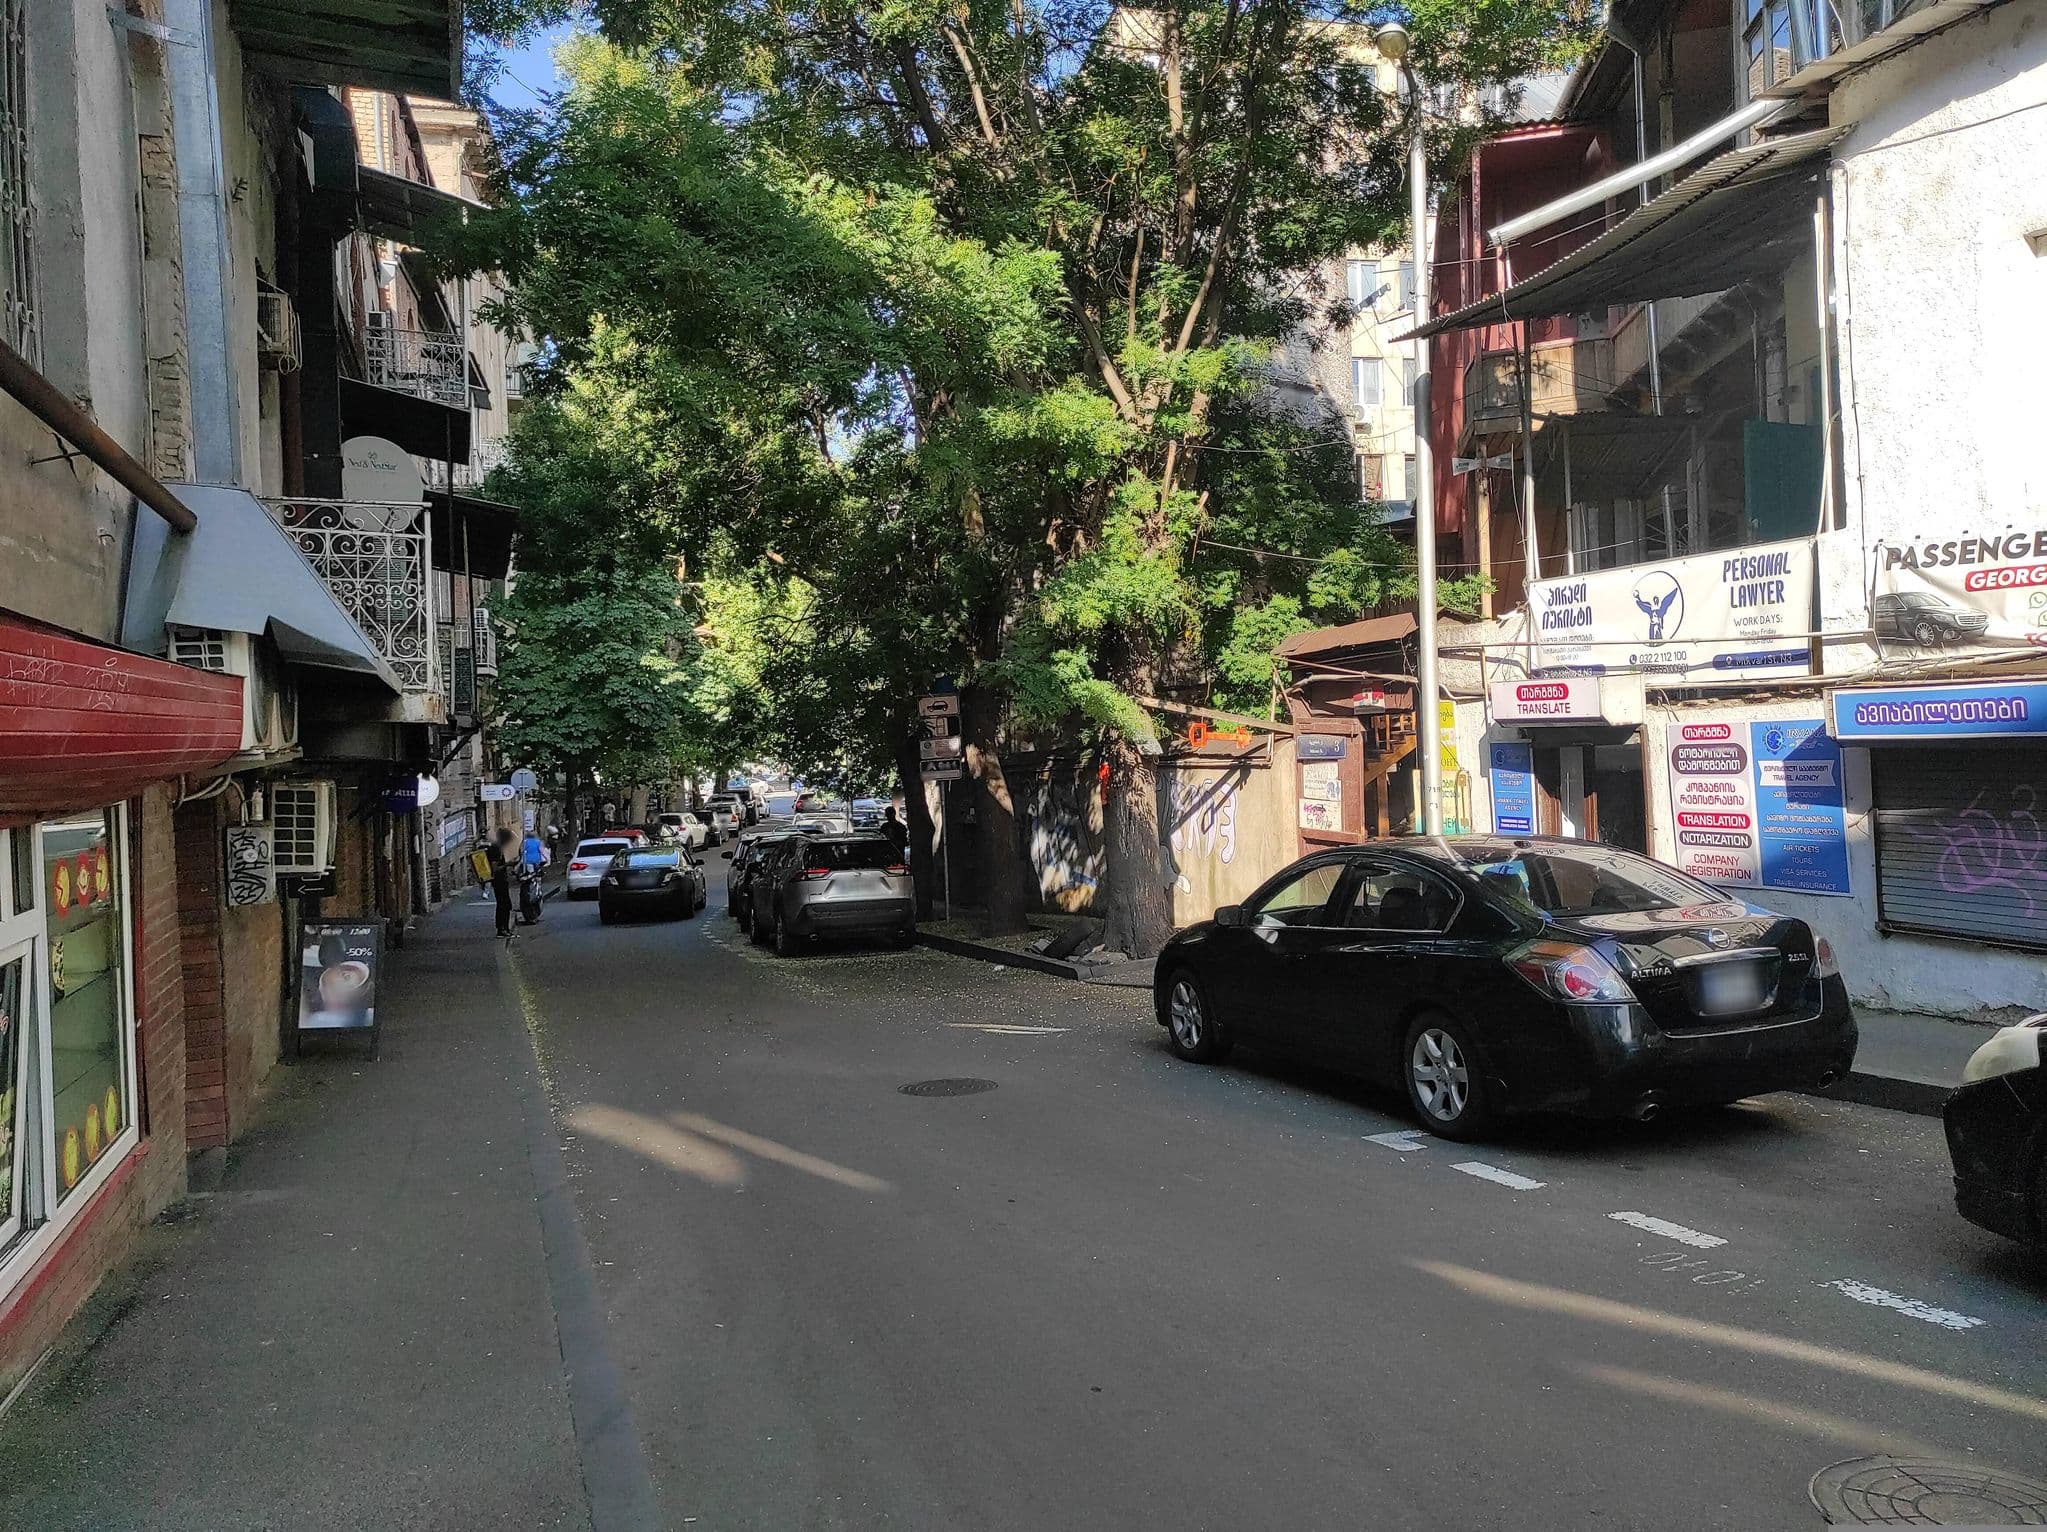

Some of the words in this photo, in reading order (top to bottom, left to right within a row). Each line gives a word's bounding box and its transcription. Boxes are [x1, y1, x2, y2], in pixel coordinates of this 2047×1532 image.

[1722, 552, 1791, 582] PERSONAL
[1548, 582, 1587, 606] პირადი
[1730, 580, 1785, 608] LAWYER
[1542, 606, 1592, 630] იურისტი
[1734, 618, 1758, 627] WORK
[1661, 651, 1672, 662] 112
[1674, 650, 1687, 661] 100
[1520, 686, 1564, 699] თარგმნა
[1517, 702, 1571, 714] TRANSLATE
[1857, 699, 2025, 723] ავიაბილეთები
[1684, 726, 1729, 738] თარგმნა
[1334, 740, 1340, 753] 3
[1678, 760, 1740, 771] დამოწმებით
[1773, 774, 1794, 782] TRAVEL
[1794, 774, 1820, 782] AGENCY
[1686, 782, 1736, 793] კომპანიის
[1680, 794, 1744, 806] რეგისტრაცია
[1682, 814, 1746, 827] TRANSLATION
[1682, 832, 1748, 847] NOTARIZATION
[1794, 845, 1820, 853] TICKETS
[1694, 854, 1740, 866] COMPANY
[1686, 865, 1752, 880] REGISTRATION
[1796, 870, 1828, 878] SERVICES
[1773, 878, 1795, 887] TRAVEL
[346, 948, 373, 957] -50%
[1630, 967, 1673, 980] ALTIMA
